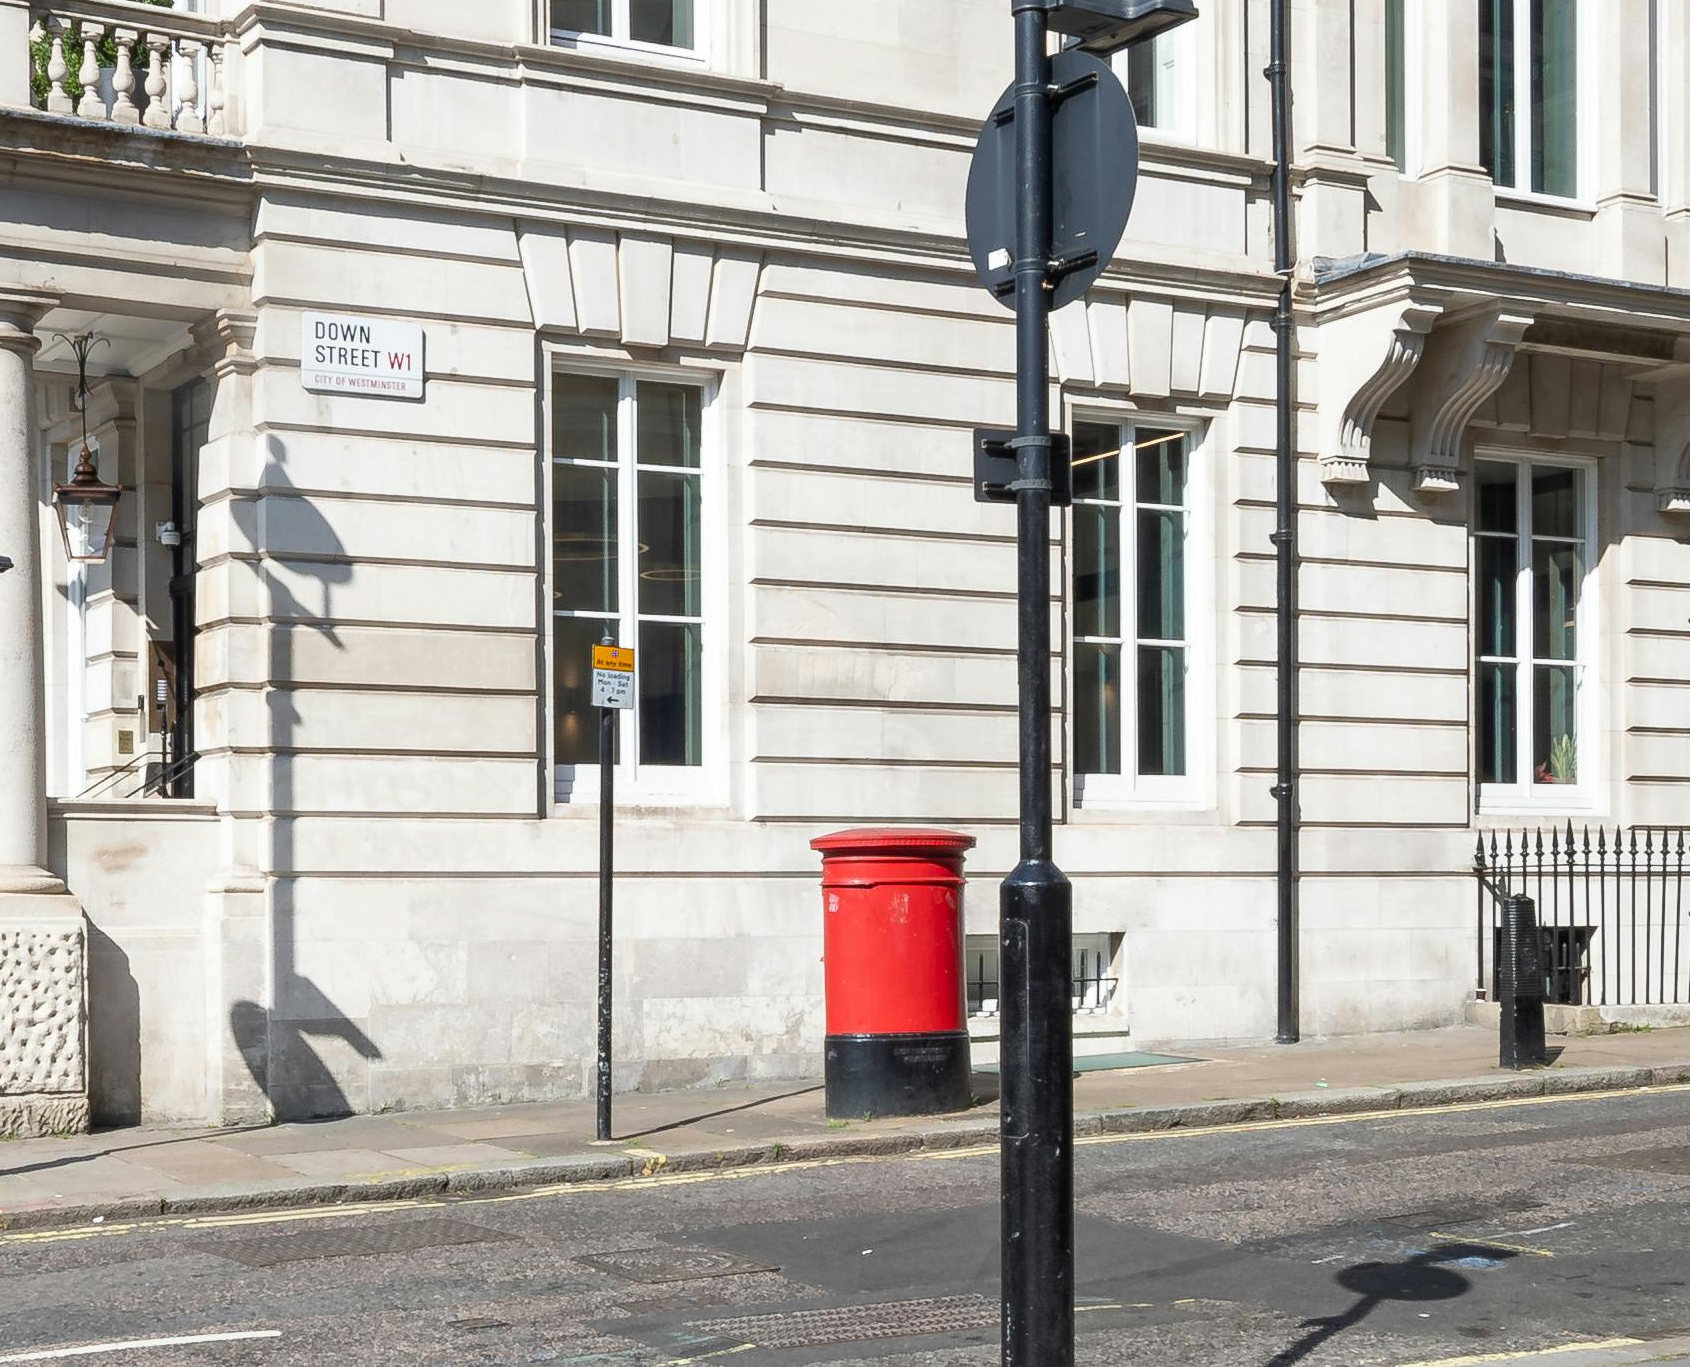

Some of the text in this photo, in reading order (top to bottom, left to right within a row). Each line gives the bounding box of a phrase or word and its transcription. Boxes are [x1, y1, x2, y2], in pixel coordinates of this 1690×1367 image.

[315, 321, 371, 344] DOWN
[315, 344, 411, 371] STREET W1
[314, 374, 407, 391] CITY OF WESTMINSTER
[608, 672, 630, 681] loading
